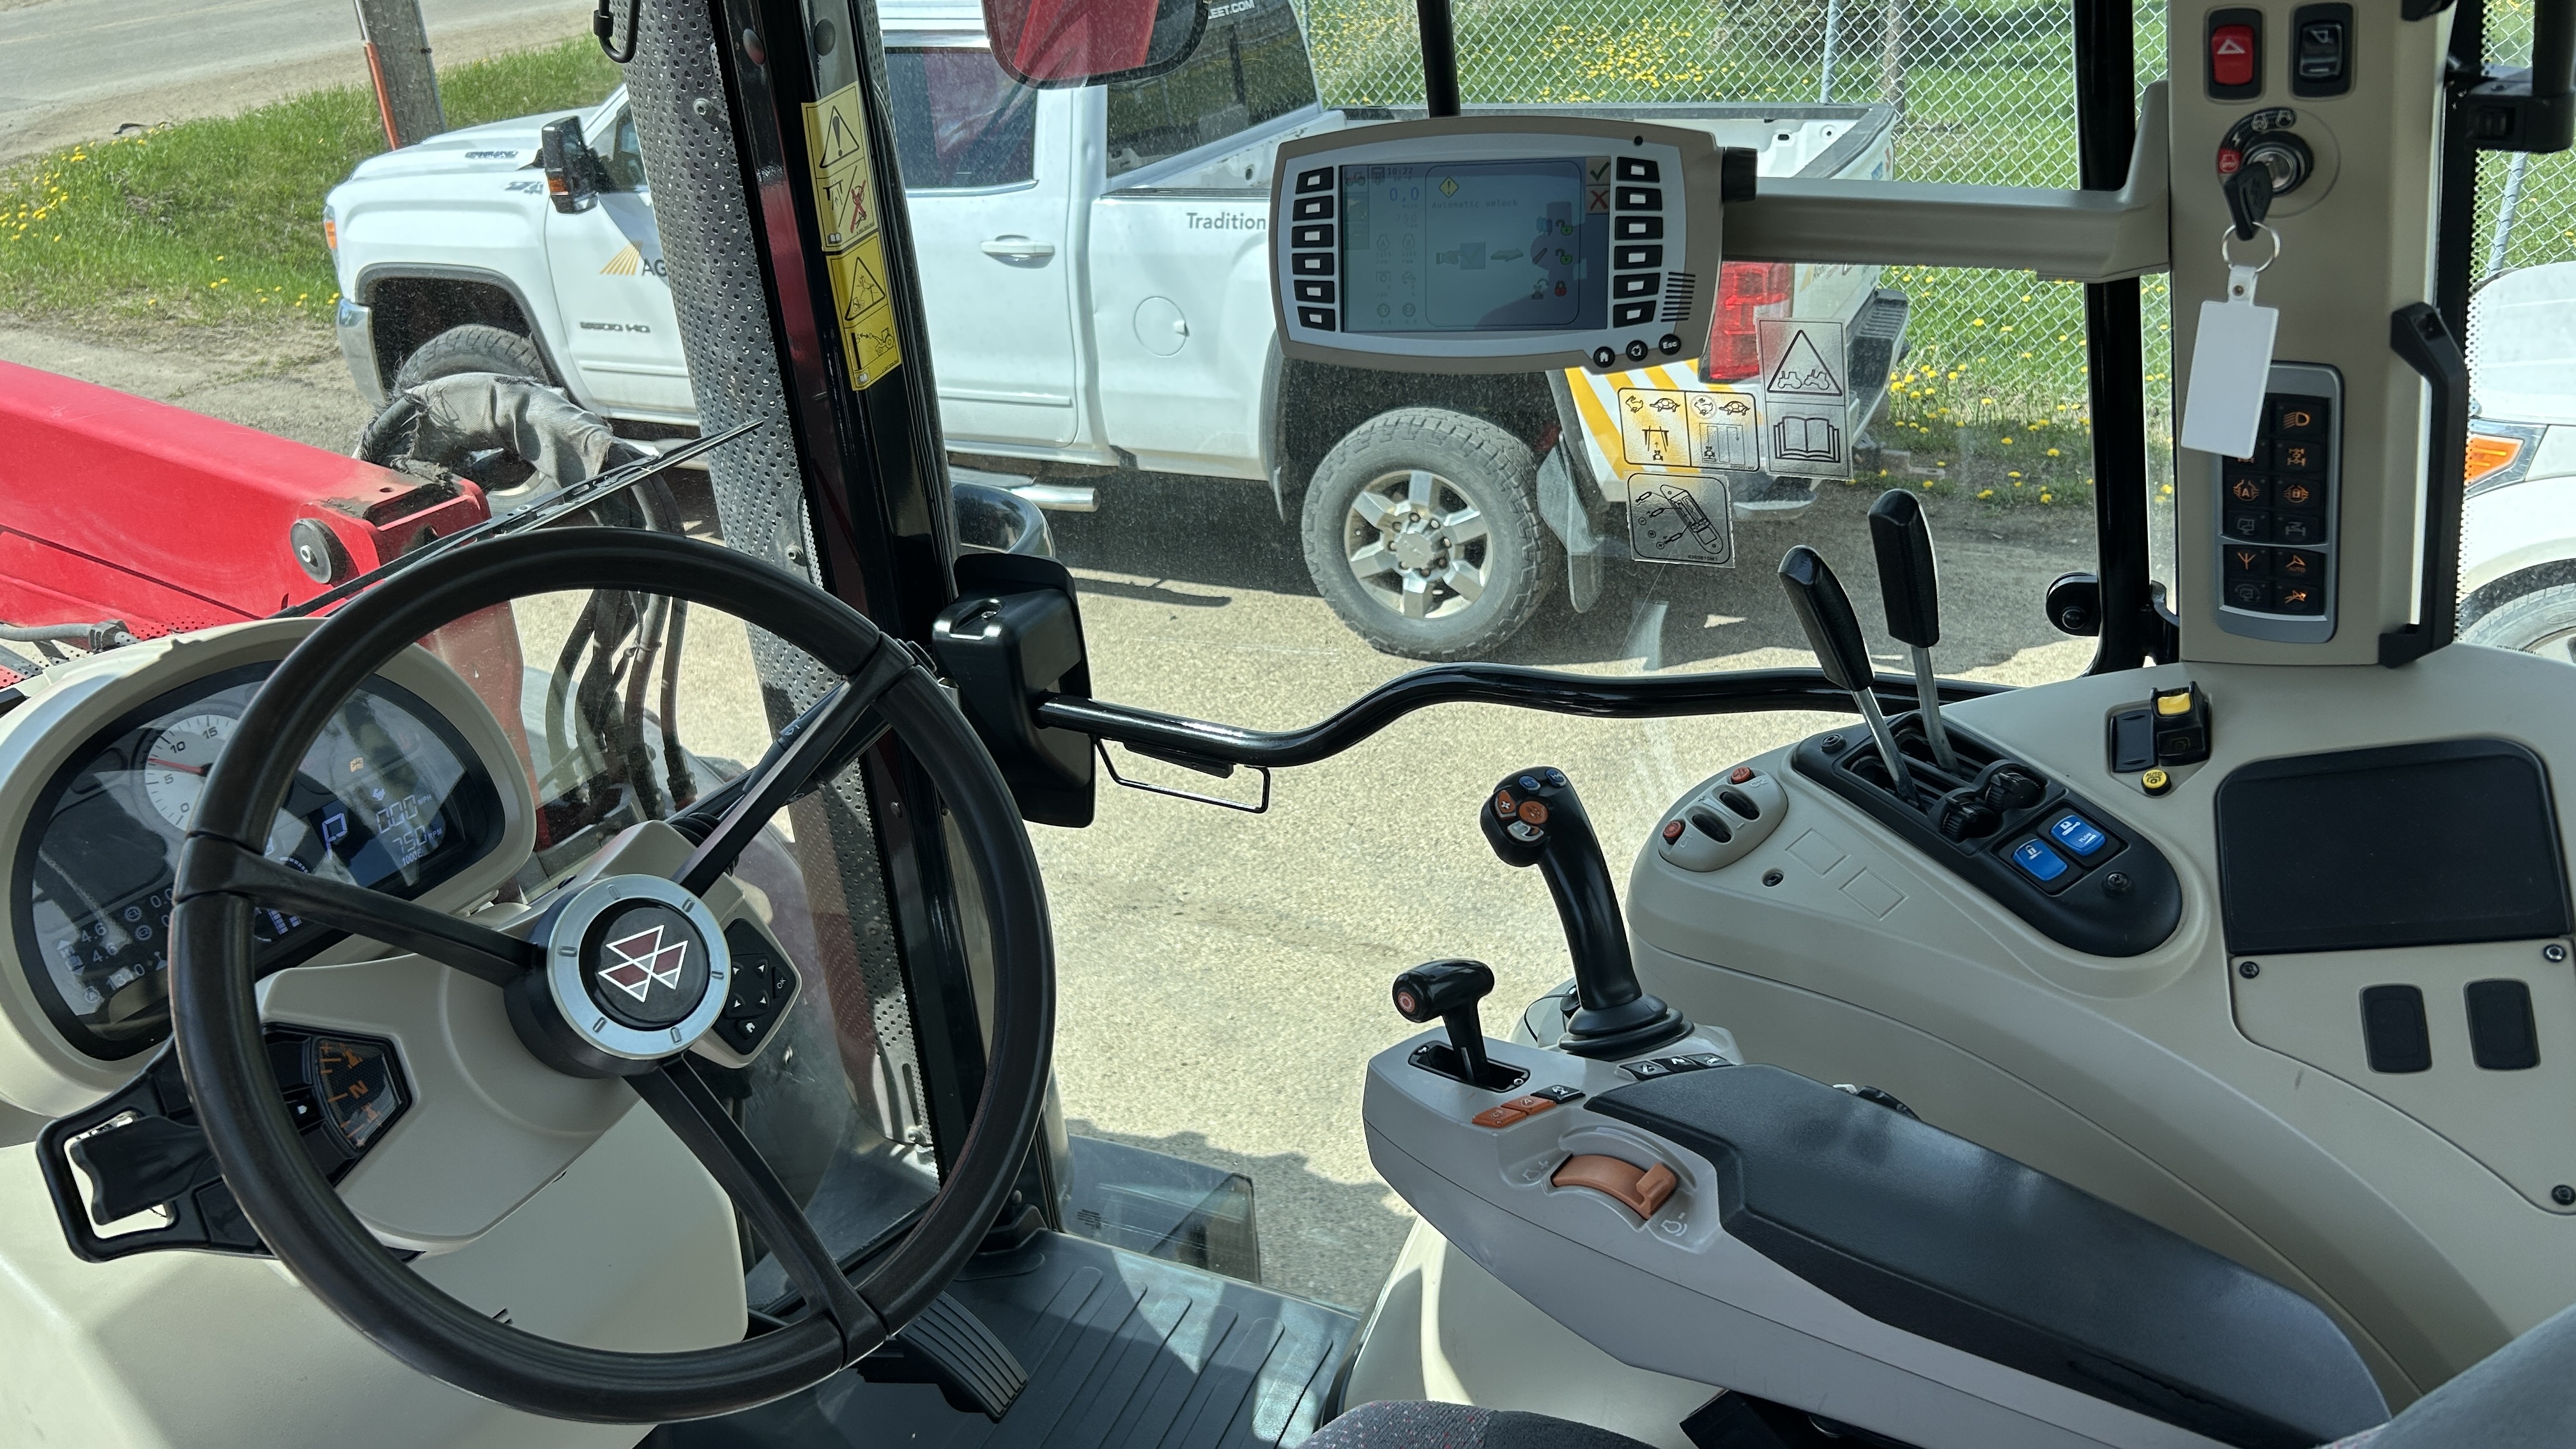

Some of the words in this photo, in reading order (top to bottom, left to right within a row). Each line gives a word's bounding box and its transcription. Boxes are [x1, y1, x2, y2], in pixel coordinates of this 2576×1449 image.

[1186, 211, 1266, 230] Tradition
[1662, 341, 1677, 349] Esc
[203, 726, 218, 739] 15
[170, 741, 186, 753] 10
[164, 773, 174, 785] 5
[418, 794, 432, 806] MPH
[180, 802, 190, 813] 0
[392, 825, 427, 854] 750
[428, 828, 443, 840] RPM
[777, 977, 786, 989] OK
